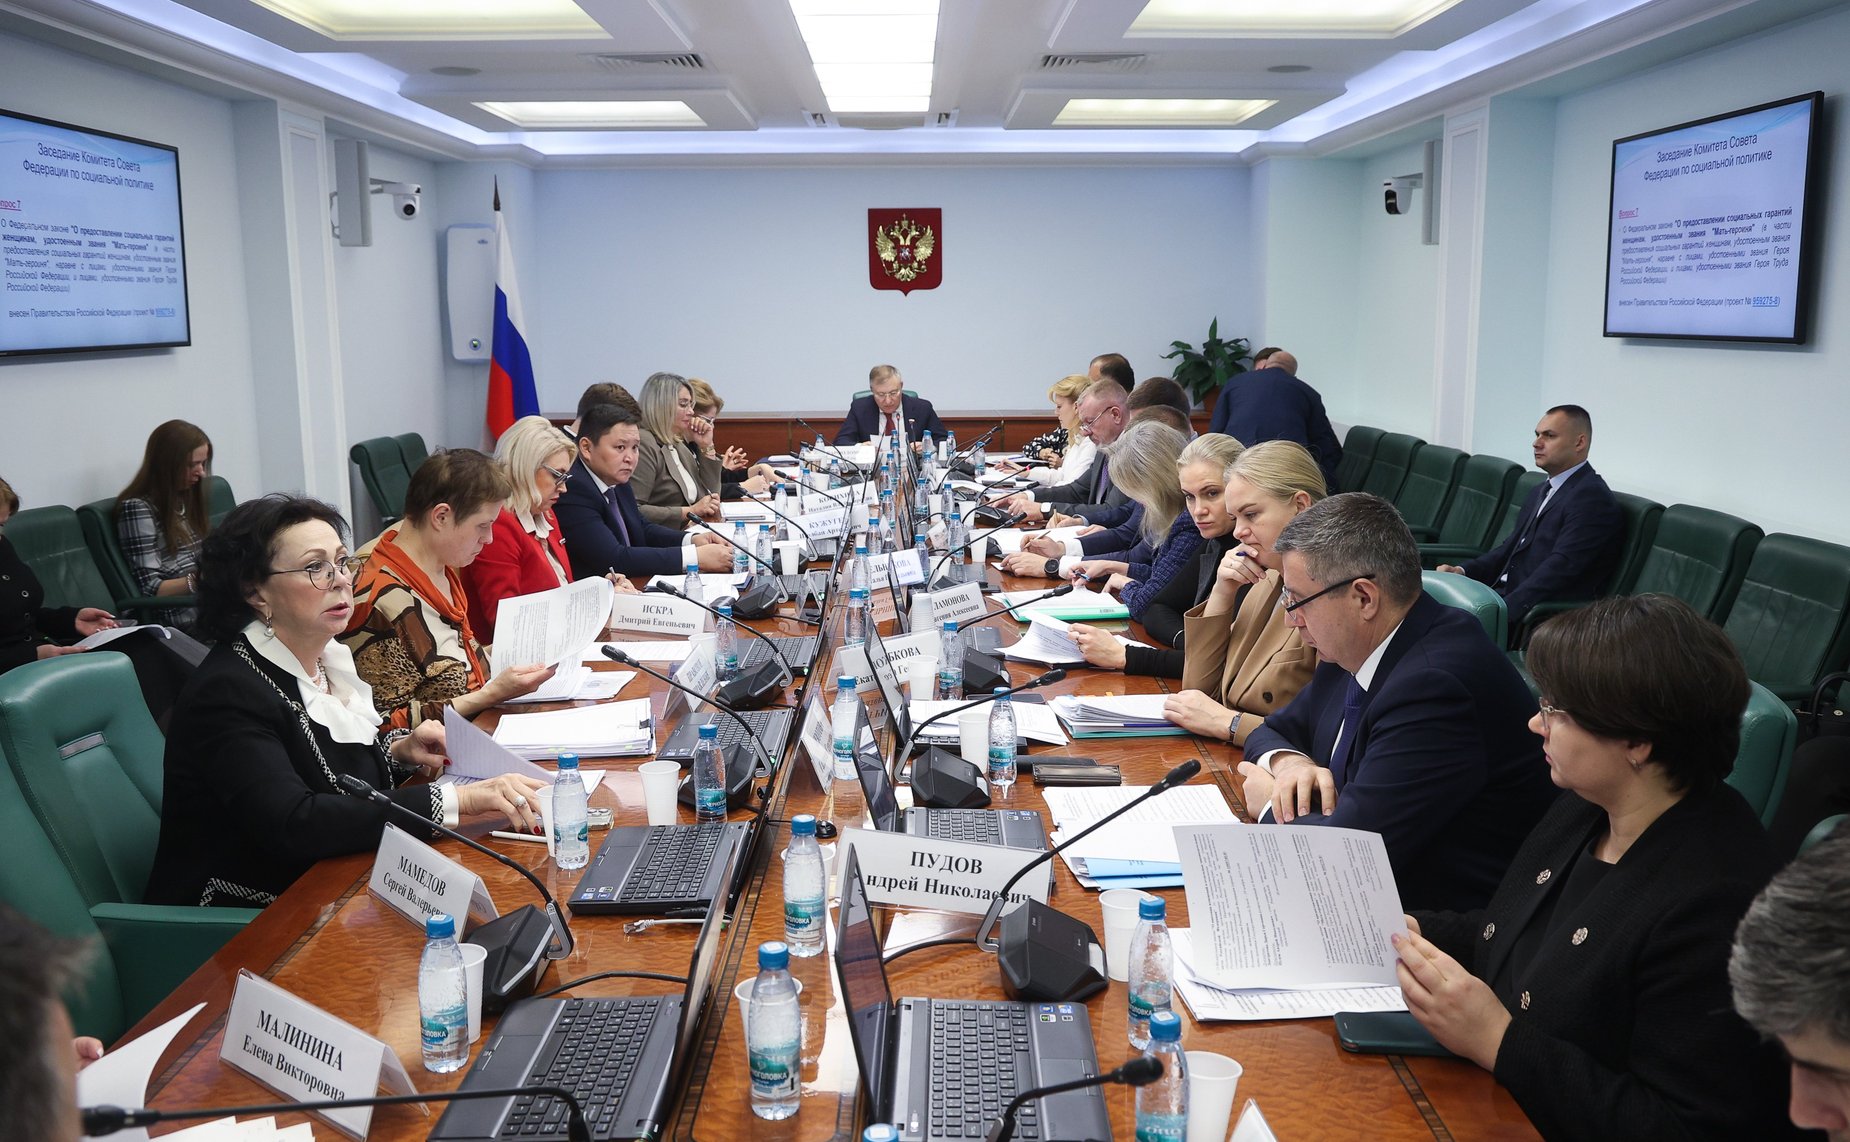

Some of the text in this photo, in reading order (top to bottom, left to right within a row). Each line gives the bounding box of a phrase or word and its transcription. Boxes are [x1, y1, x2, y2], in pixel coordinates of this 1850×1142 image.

[38, 142, 140, 172] Заседание Комитета Совета
[1657, 134, 1758, 163] Заседание Комитета Совета
[23, 159, 154, 190] Федерации по социальной политике
[1644, 150, 1772, 181] Федерации по социальной политике
[1726, 212, 1762, 222] социальных
[1764, 206, 1792, 219] гарантий
[618, 615, 696, 630] Дмитрий Евгеньевич
[642, 604, 674, 616] ИСКРА
[397, 855, 447, 897] МАМЕДОВ
[910, 851, 983, 875] ПУДОВ
[383, 872, 408, 897] Сергей
[866, 874, 918, 892] ндрей
[256, 1010, 342, 1072] МАЛИНИНА
[242, 1034, 345, 1101] Елена Викторовна
